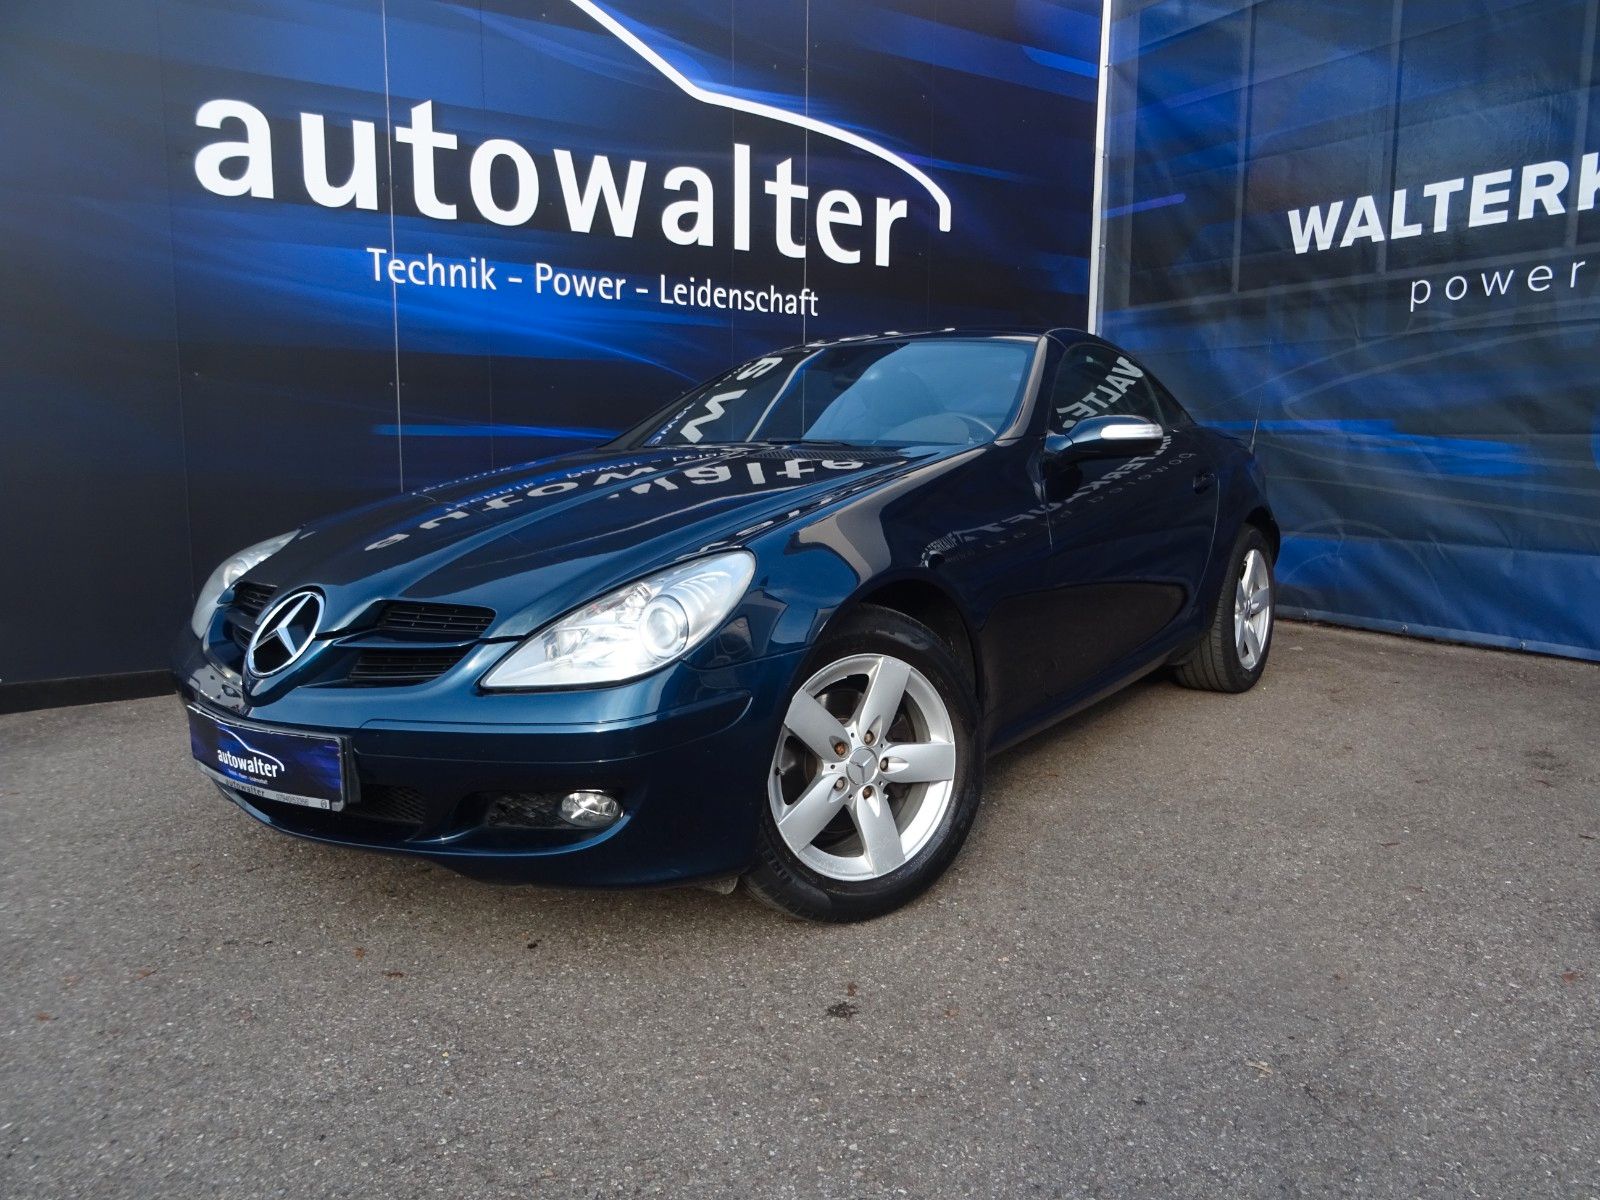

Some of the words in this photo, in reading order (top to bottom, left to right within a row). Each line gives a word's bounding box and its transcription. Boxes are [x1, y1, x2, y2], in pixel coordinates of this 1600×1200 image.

[193, 98, 909, 267] autowalter
[366, 247, 497, 292] Technik
[535, 262, 627, 301] Power
[660, 273, 819, 317] Leidenschaft
[1409, 260, 1586, 313] power
[217, 749, 278, 778] autowalter
